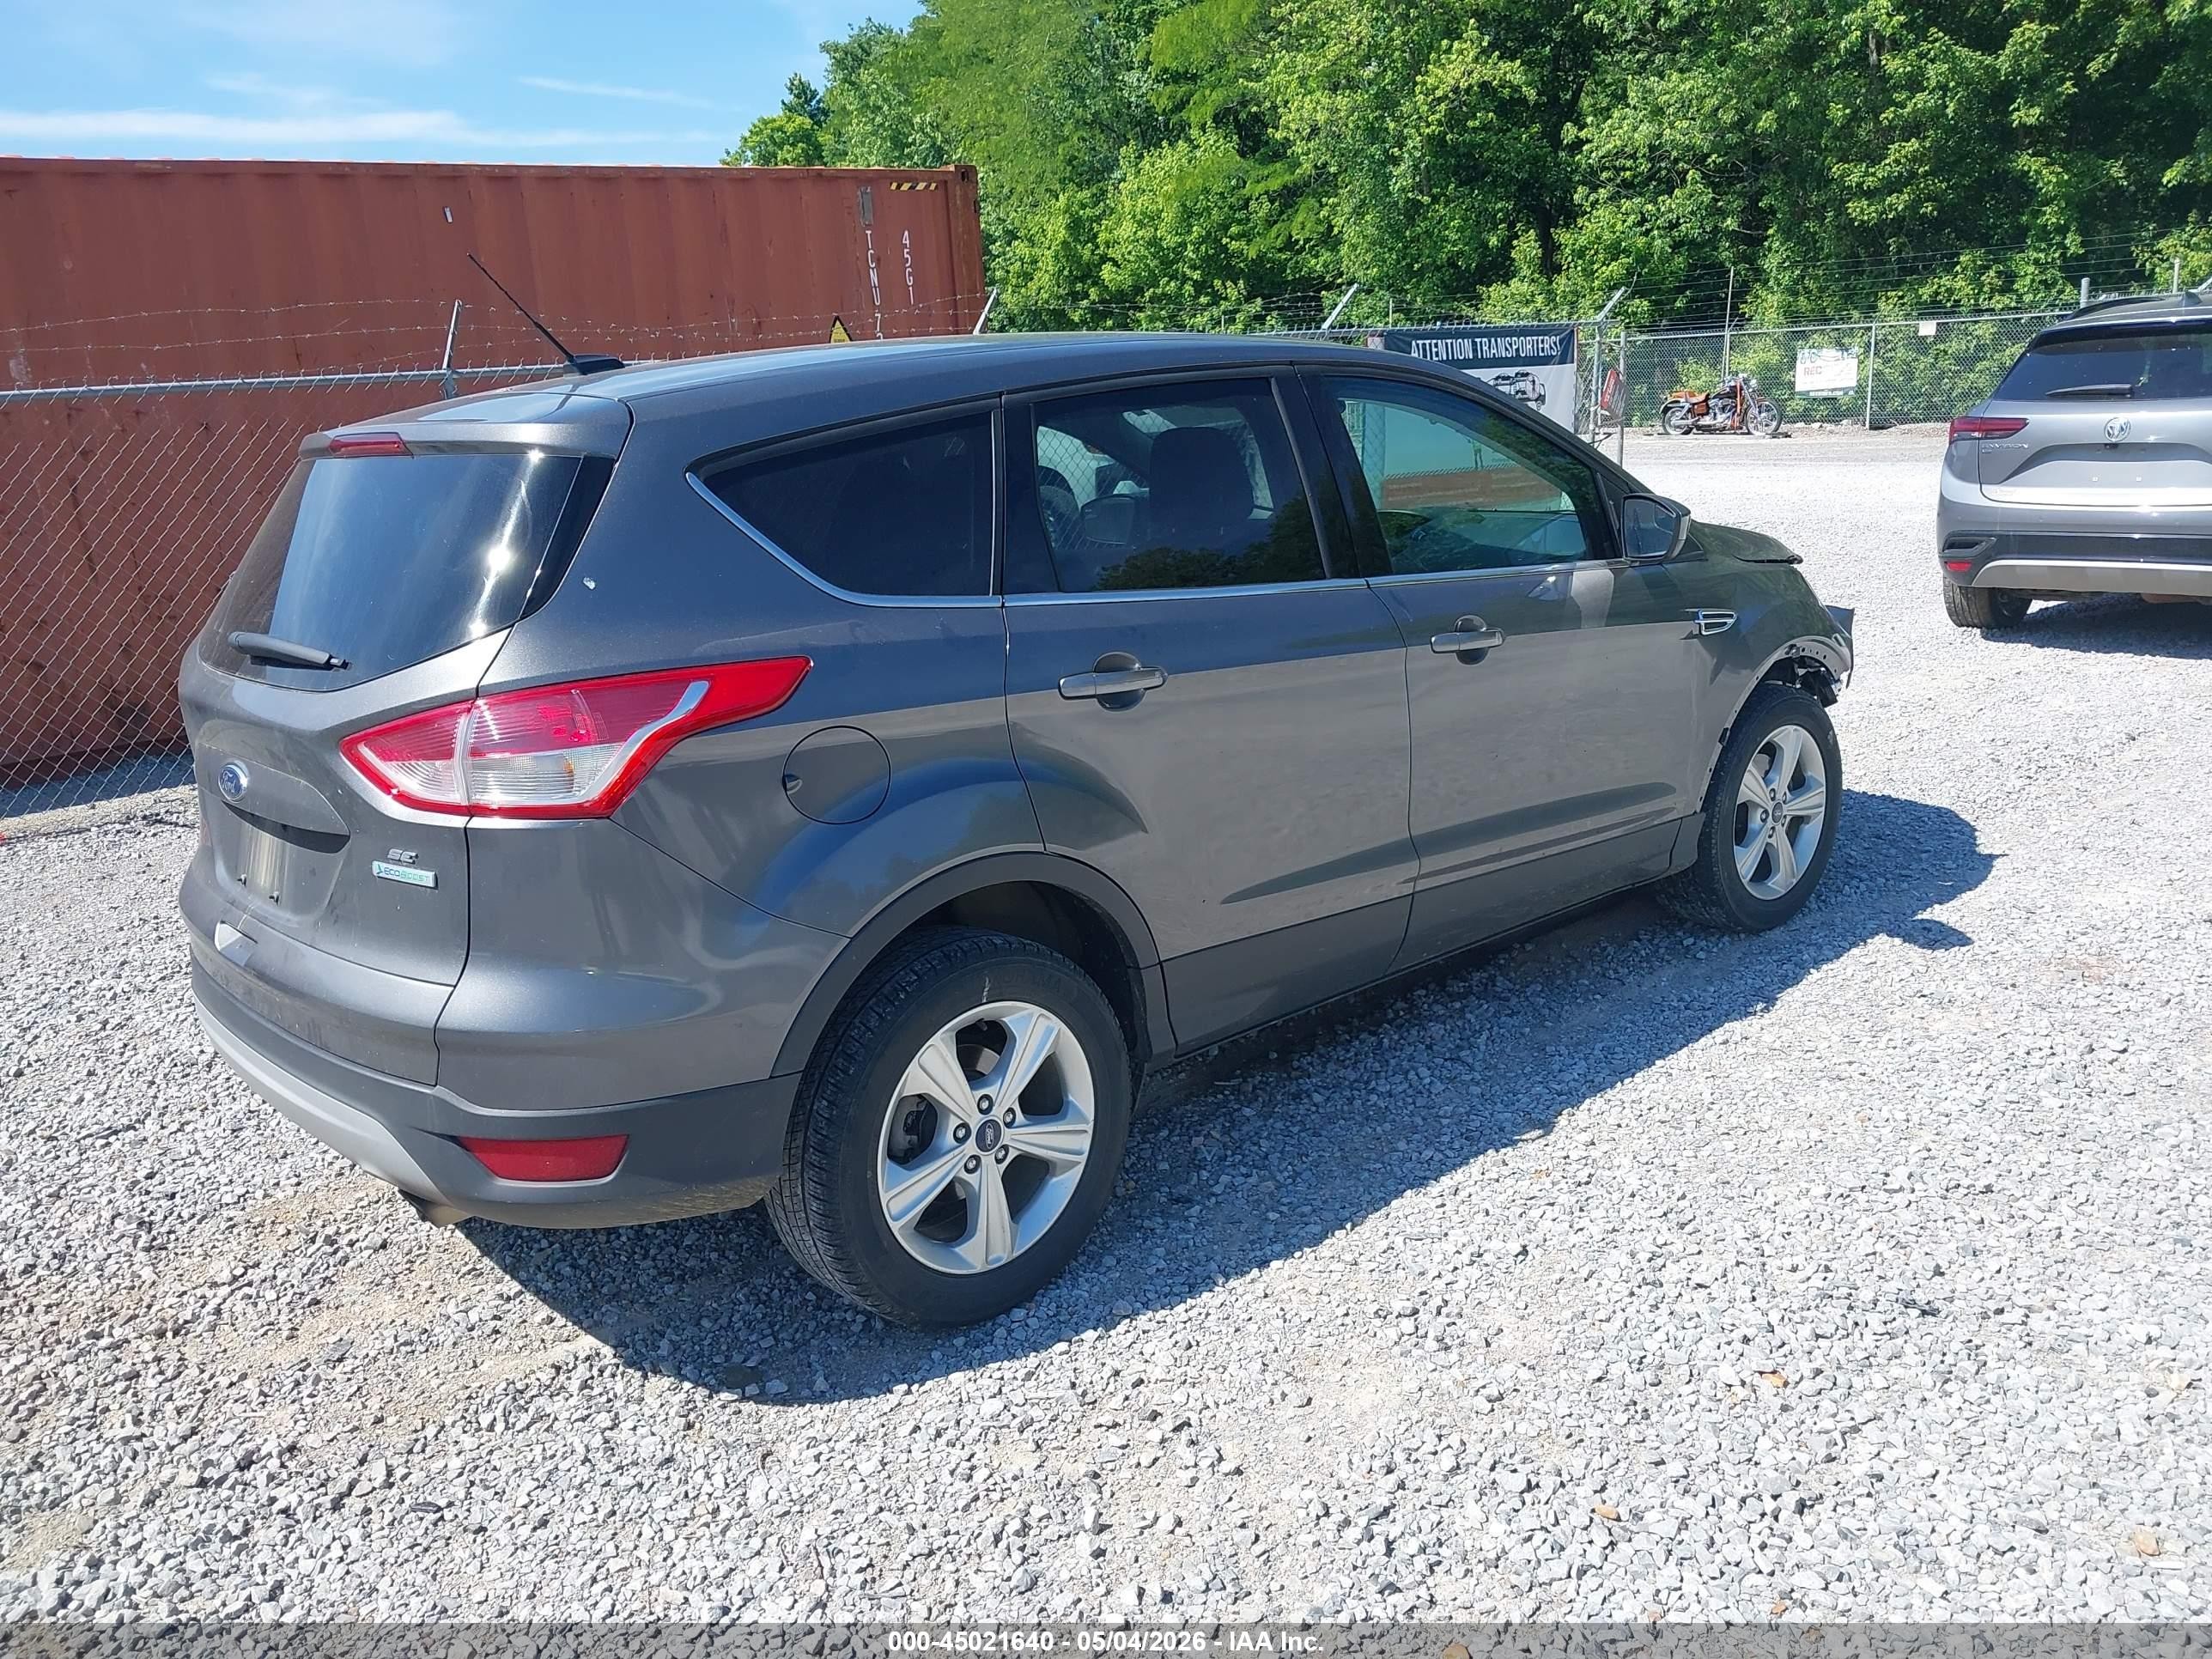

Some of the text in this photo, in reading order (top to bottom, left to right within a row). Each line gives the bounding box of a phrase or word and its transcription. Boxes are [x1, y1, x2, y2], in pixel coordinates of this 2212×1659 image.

[866, 229, 881, 307] TCNU
[902, 230, 914, 305] 45G1
[1411, 336, 1560, 362] ATTENTION TRANSPORTERS!
[221, 770, 236, 793] Ford
[387, 848, 417, 864] SE
